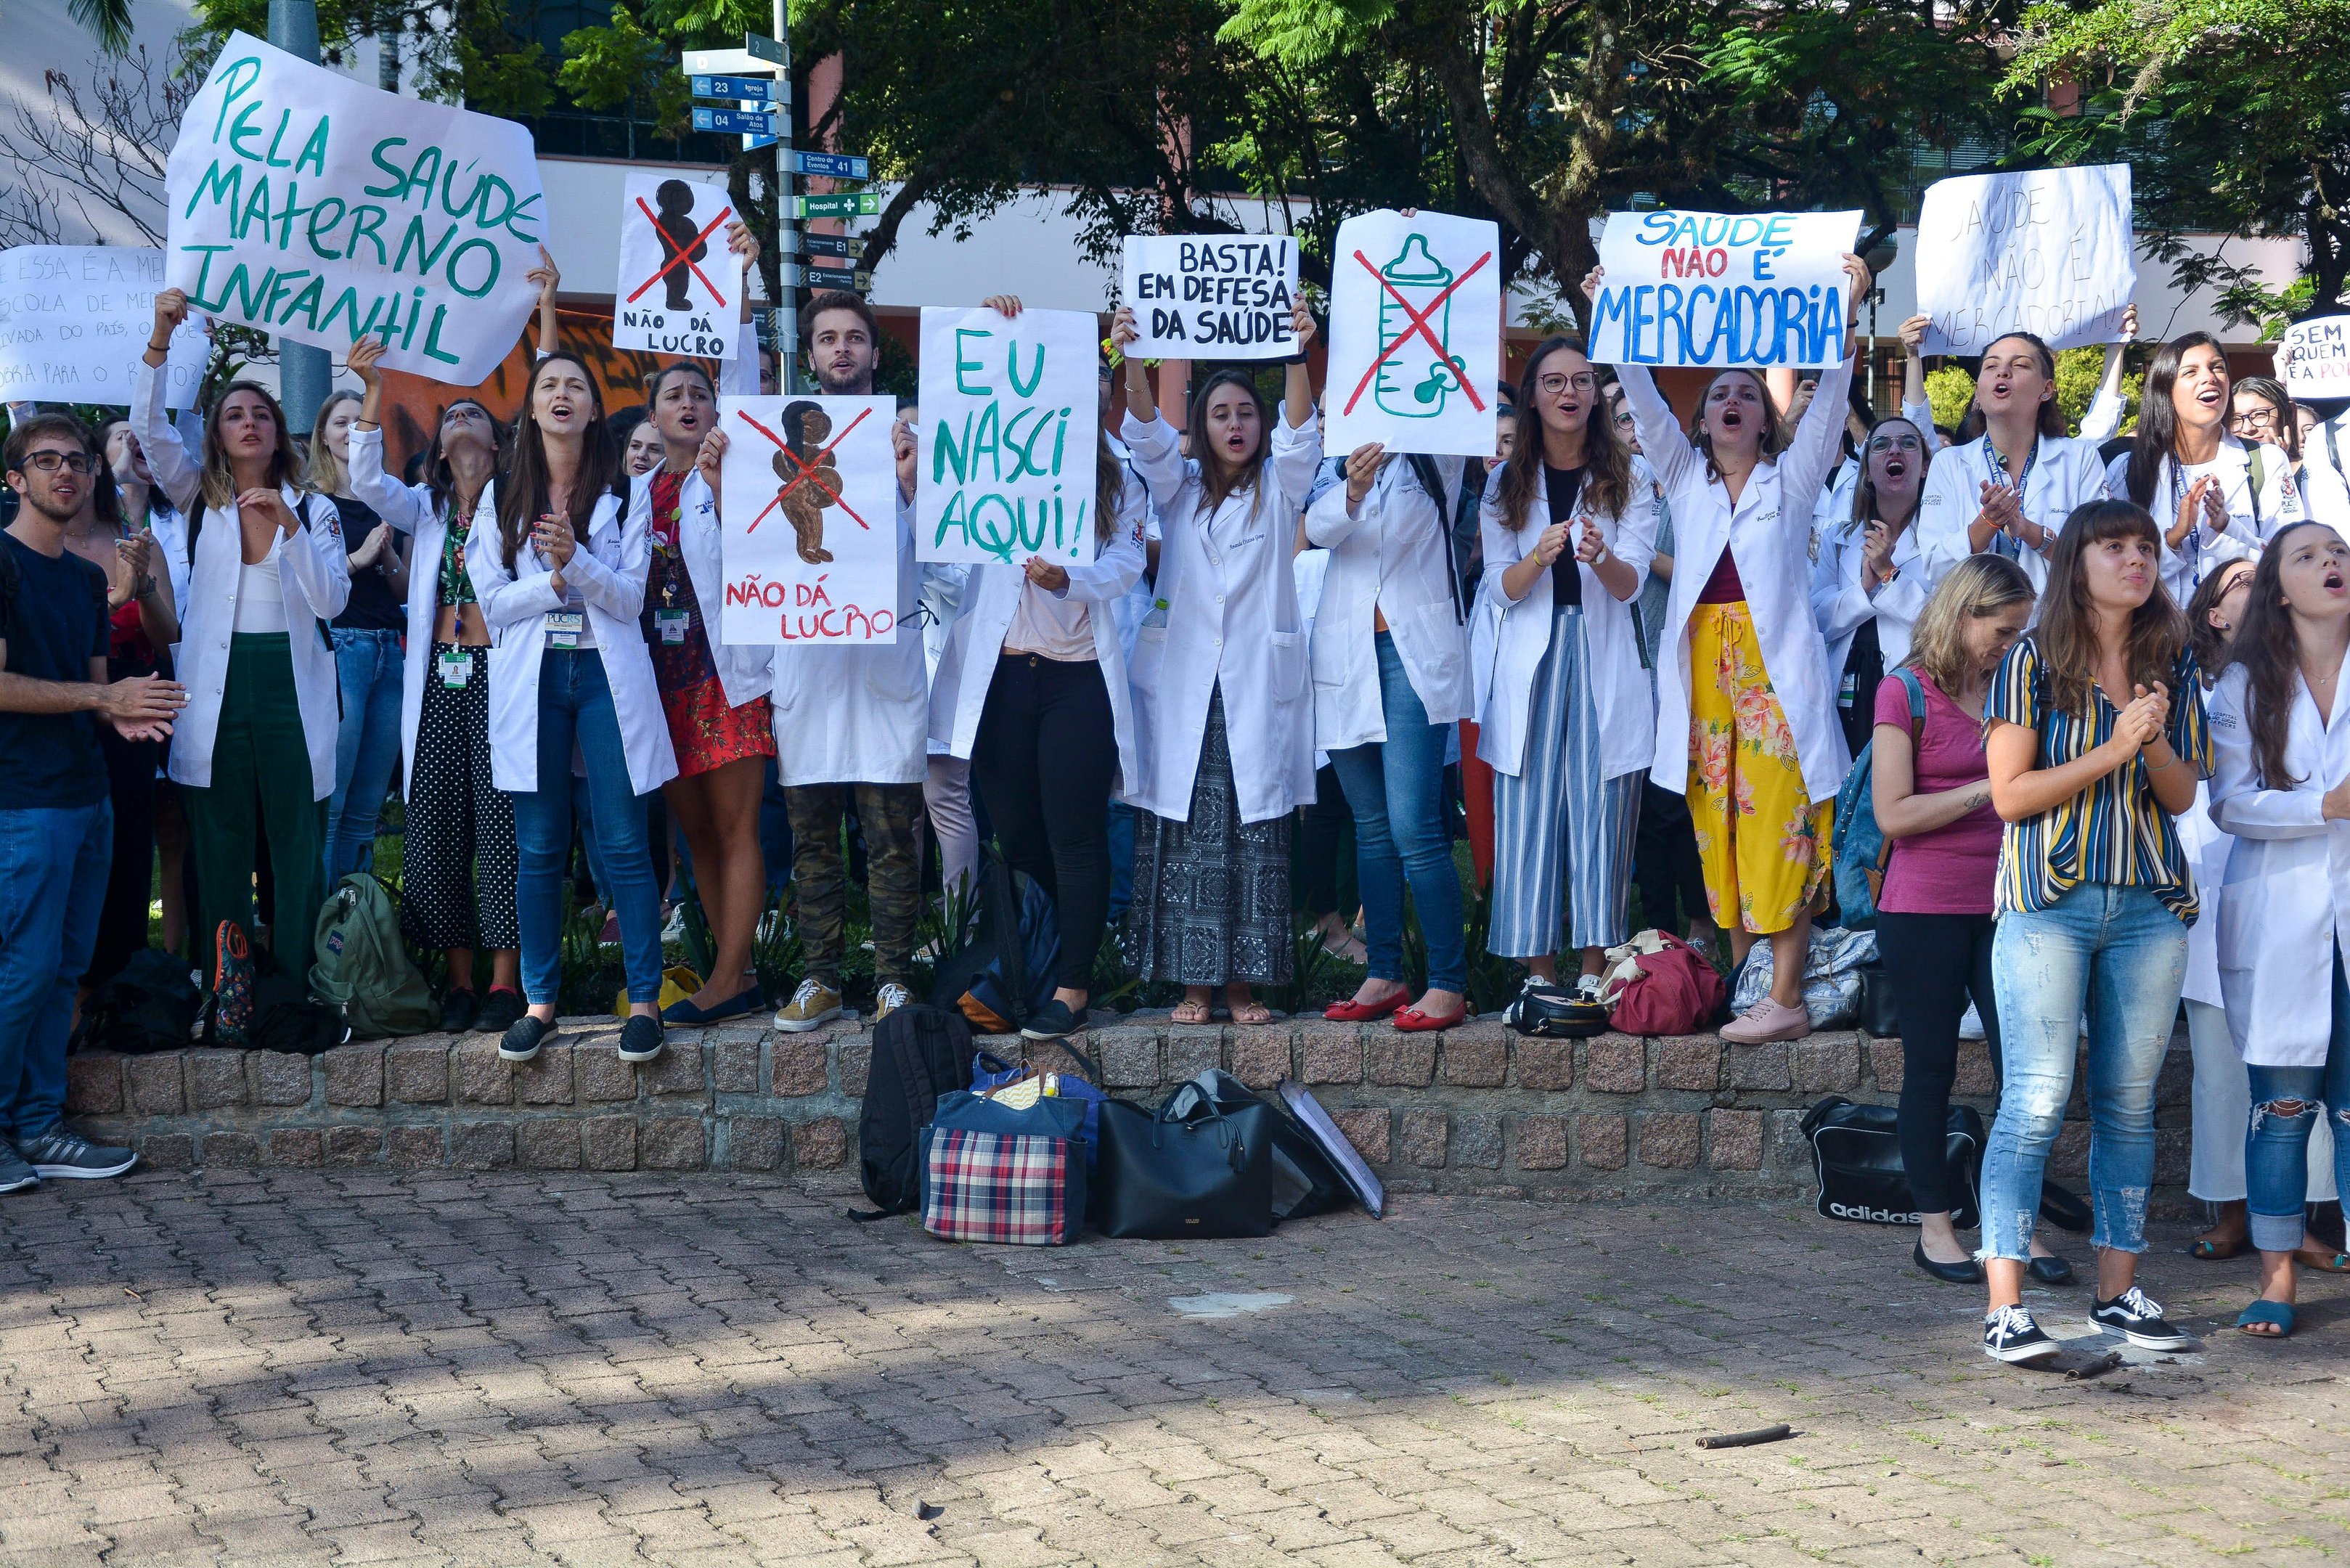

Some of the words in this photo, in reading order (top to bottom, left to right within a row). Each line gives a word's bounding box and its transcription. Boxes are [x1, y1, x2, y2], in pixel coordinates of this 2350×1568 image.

[714, 81, 729, 93] 23
[745, 83, 764, 92] Igreja
[715, 115, 729, 126] 04
[213, 56, 329, 177] PELA
[364, 137, 542, 243] SAÚDE
[837, 161, 848, 172] 41
[809, 202, 839, 211] Hospital
[1636, 211, 1798, 248] SAÚDE
[836, 241, 846, 252] E1
[19, 255, 71, 281] ESSA
[82, 250, 99, 281] É
[107, 256, 125, 282] A
[1180, 239, 1287, 277] BASTA!
[1660, 245, 1729, 279] NÃO
[1753, 246, 1786, 280] É
[1983, 244, 2046, 295] NÃO
[2070, 224, 2092, 282] É
[809, 271, 822, 282] E2
[1138, 271, 1175, 300] EM
[1183, 274, 1292, 310] DEFESA
[86, 294, 113, 312] DE
[60, 324, 83, 340] DO
[97, 319, 128, 338] PAÍS,
[139, 321, 151, 335] O
[623, 309, 664, 329] NÃO
[690, 311, 713, 333] DÁ
[1152, 309, 1186, 340] DA
[1197, 305, 1292, 345] SAÚDE
[647, 333, 725, 356] LUCRO
[2290, 324, 2341, 345] SEM
[955, 329, 1045, 398] EU
[2292, 343, 2346, 362] QUEM
[44, 362, 80, 384] PARA
[93, 366, 108, 382] O
[2303, 366, 2314, 379] A
[726, 573, 786, 608] NÃO
[796, 573, 831, 608] DÁ
[547, 613, 581, 624] PUCRS
[780, 603, 894, 640] LUCRO
[1829, 1202, 1922, 1224] adidas
